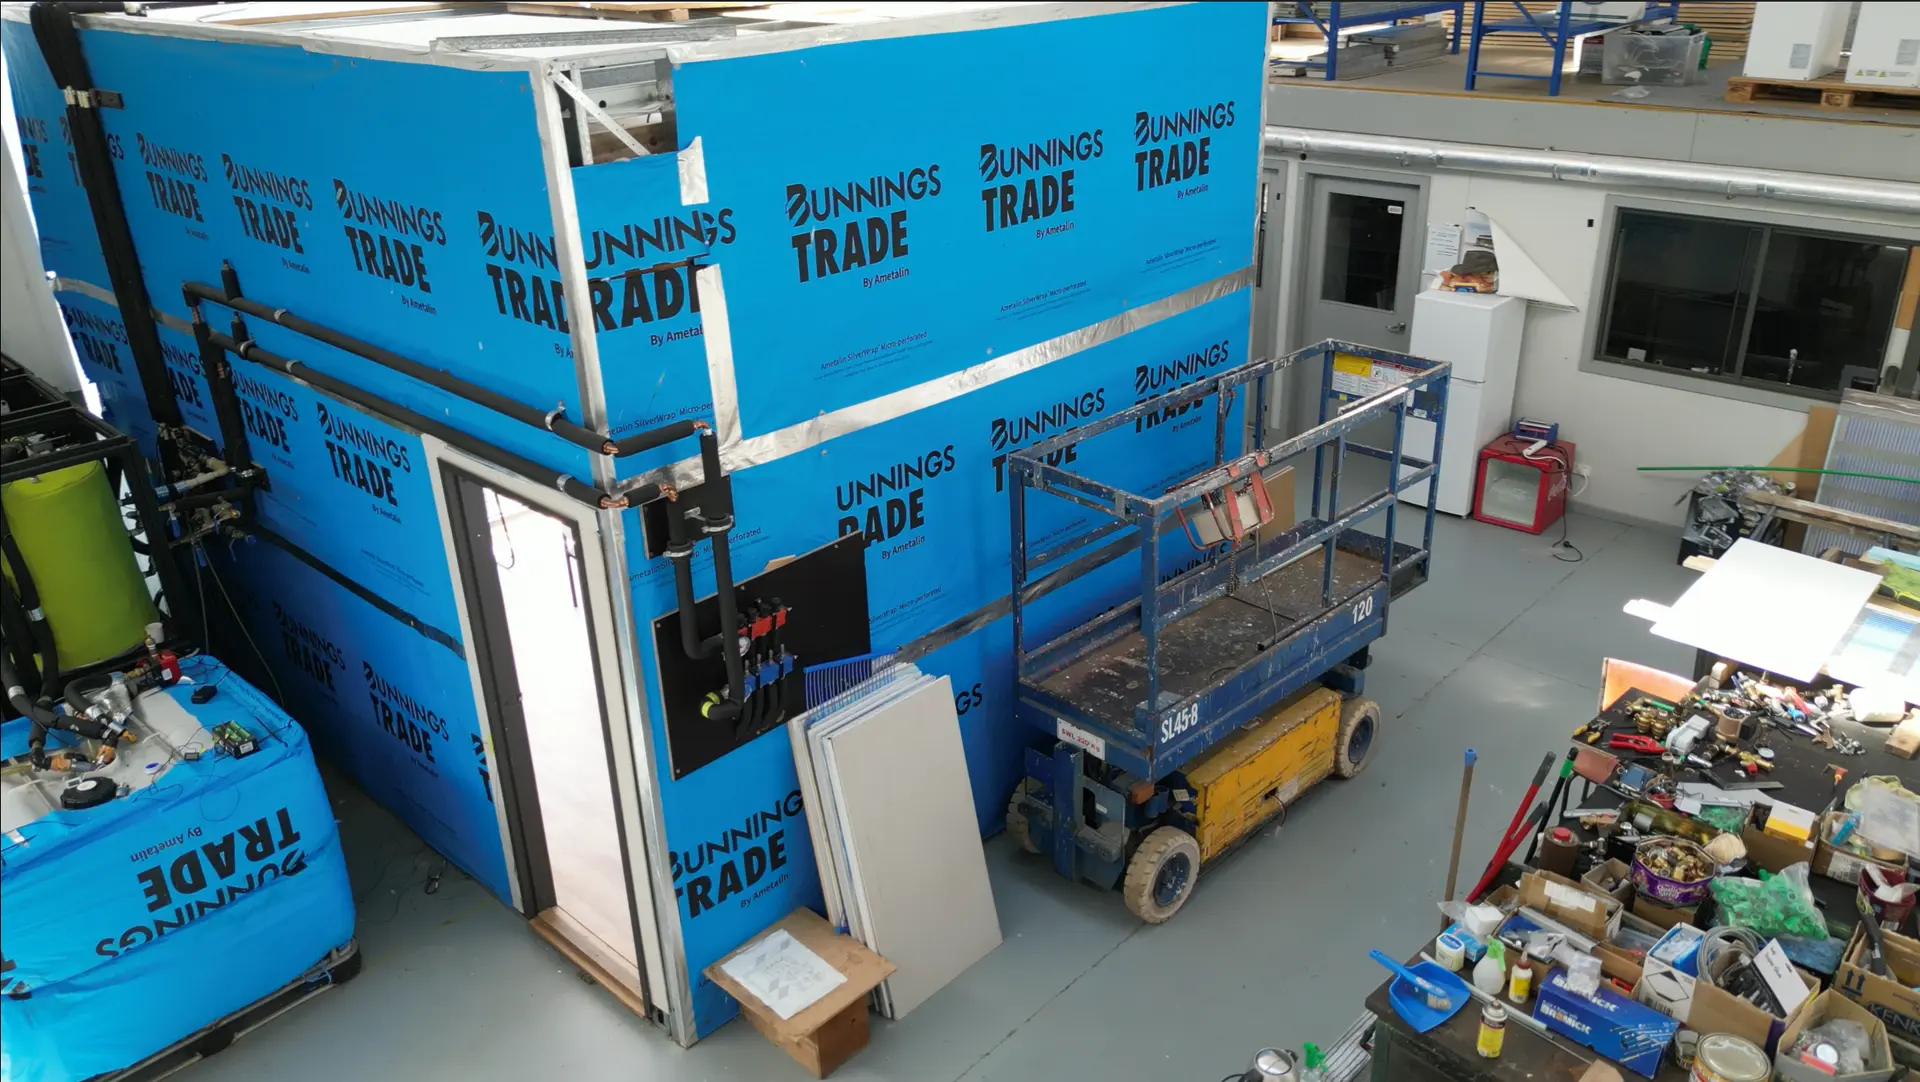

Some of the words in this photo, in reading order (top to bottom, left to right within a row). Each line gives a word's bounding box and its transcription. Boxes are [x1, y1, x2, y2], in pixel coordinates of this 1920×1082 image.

[1134, 100, 1235, 146] BUNNINGS
[136, 132, 208, 183] BUNNINGS
[221, 153, 312, 212] BUNNINGS
[979, 128, 1104, 182] BUNNINGS
[1135, 136, 1211, 192] TRADE
[146, 171, 204, 223] TRADE
[333, 178, 446, 246] BUNNINGS
[785, 164, 942, 227] BUNNINGS
[981, 169, 1075, 232] TRADE
[1177, 189, 1185, 200] By
[232, 195, 304, 255] TRADE
[791, 209, 909, 284] TRADE
[1036, 228, 1045, 240] By
[1045, 220, 1075, 236] Ametalin
[344, 225, 432, 294] TRADE
[863, 276, 873, 289] By
[874, 267, 910, 285] Ametalin
[650, 334, 663, 347] By
[1135, 340, 1230, 396] BUNNINGS
[240, 398, 291, 454] RADE
[316, 401, 411, 473] BUNNINGS
[990, 388, 1105, 451] BUNNINGS
[325, 439, 398, 507] TRADE
[881, 550, 891, 560] By
[892, 535, 926, 556] Ametalin
[1352, 595, 1373, 625] 120
[362, 659, 450, 743] BUNNINGS
[369, 691, 436, 764] TRADE
[1061, 727, 1076, 740] SWL
[130, 834, 184, 863] Ametalin
[137, 806, 301, 913] TRADE
[187, 826, 203, 839] By
[95, 848, 309, 959] BUNNINGS
[1540, 1002, 1592, 1035] BROMICK
